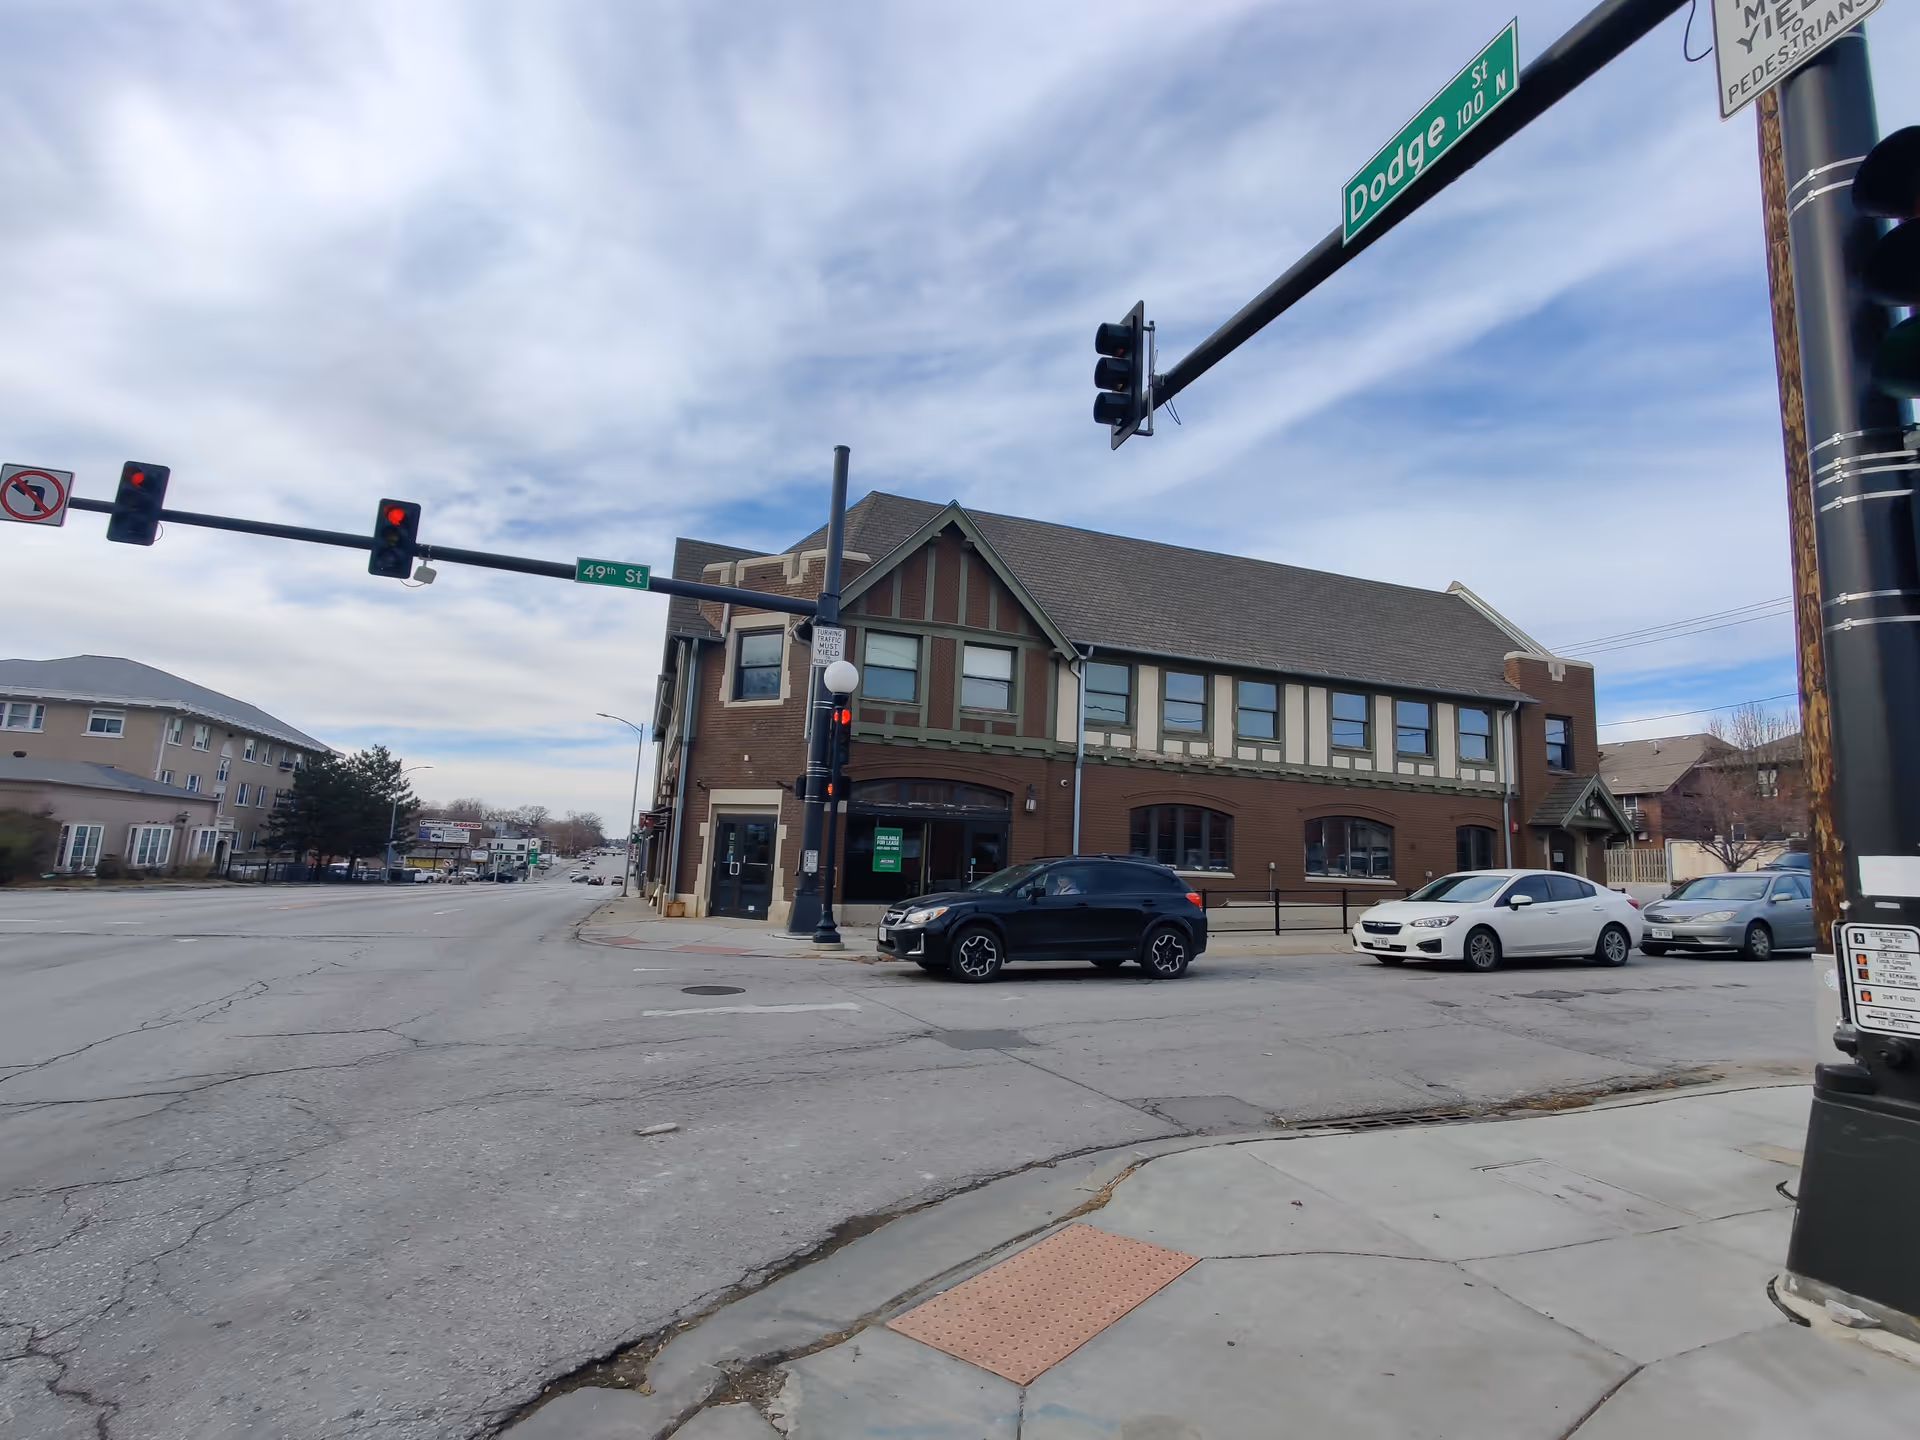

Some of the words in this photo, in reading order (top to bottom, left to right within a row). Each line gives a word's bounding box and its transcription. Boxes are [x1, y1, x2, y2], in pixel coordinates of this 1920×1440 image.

[1736, 0, 1817, 54] YIEL
[1780, 18, 1804, 40] TO
[1456, 90, 1484, 130] 100
[1496, 67, 1506, 95] N
[1351, 116, 1445, 224] Dodge
[1471, 59, 1488, 89] St
[583, 565, 616, 579] 49th
[625, 569, 643, 583] St
[817, 629, 841, 637] TURNING
